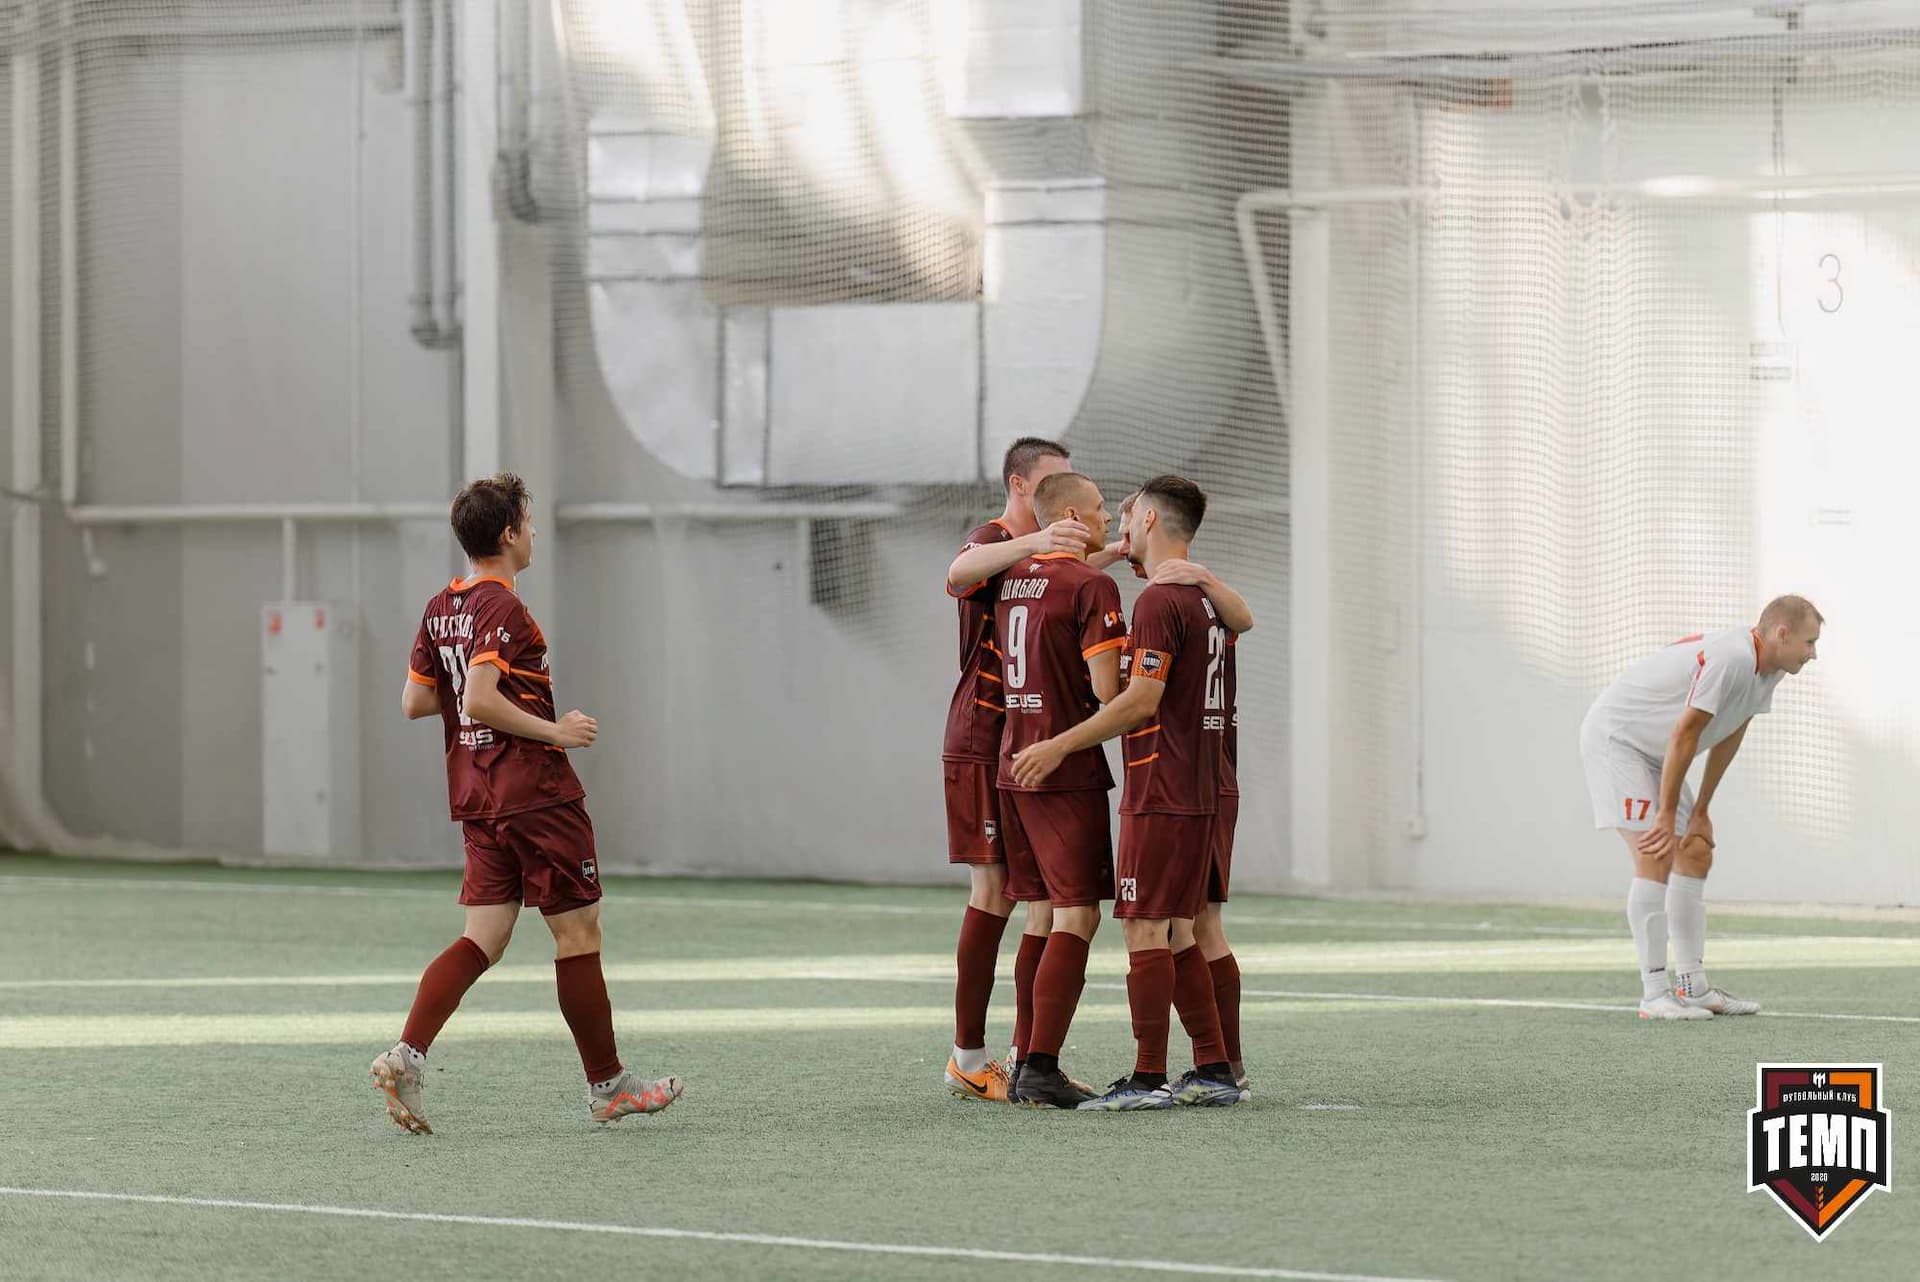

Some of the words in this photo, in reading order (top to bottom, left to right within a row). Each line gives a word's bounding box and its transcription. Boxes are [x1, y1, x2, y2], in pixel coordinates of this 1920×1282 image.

[1818, 253, 1844, 313] 3
[1007, 605, 1029, 689] 9
[1625, 798, 1651, 820] 17
[1120, 877, 1137, 902] 23
